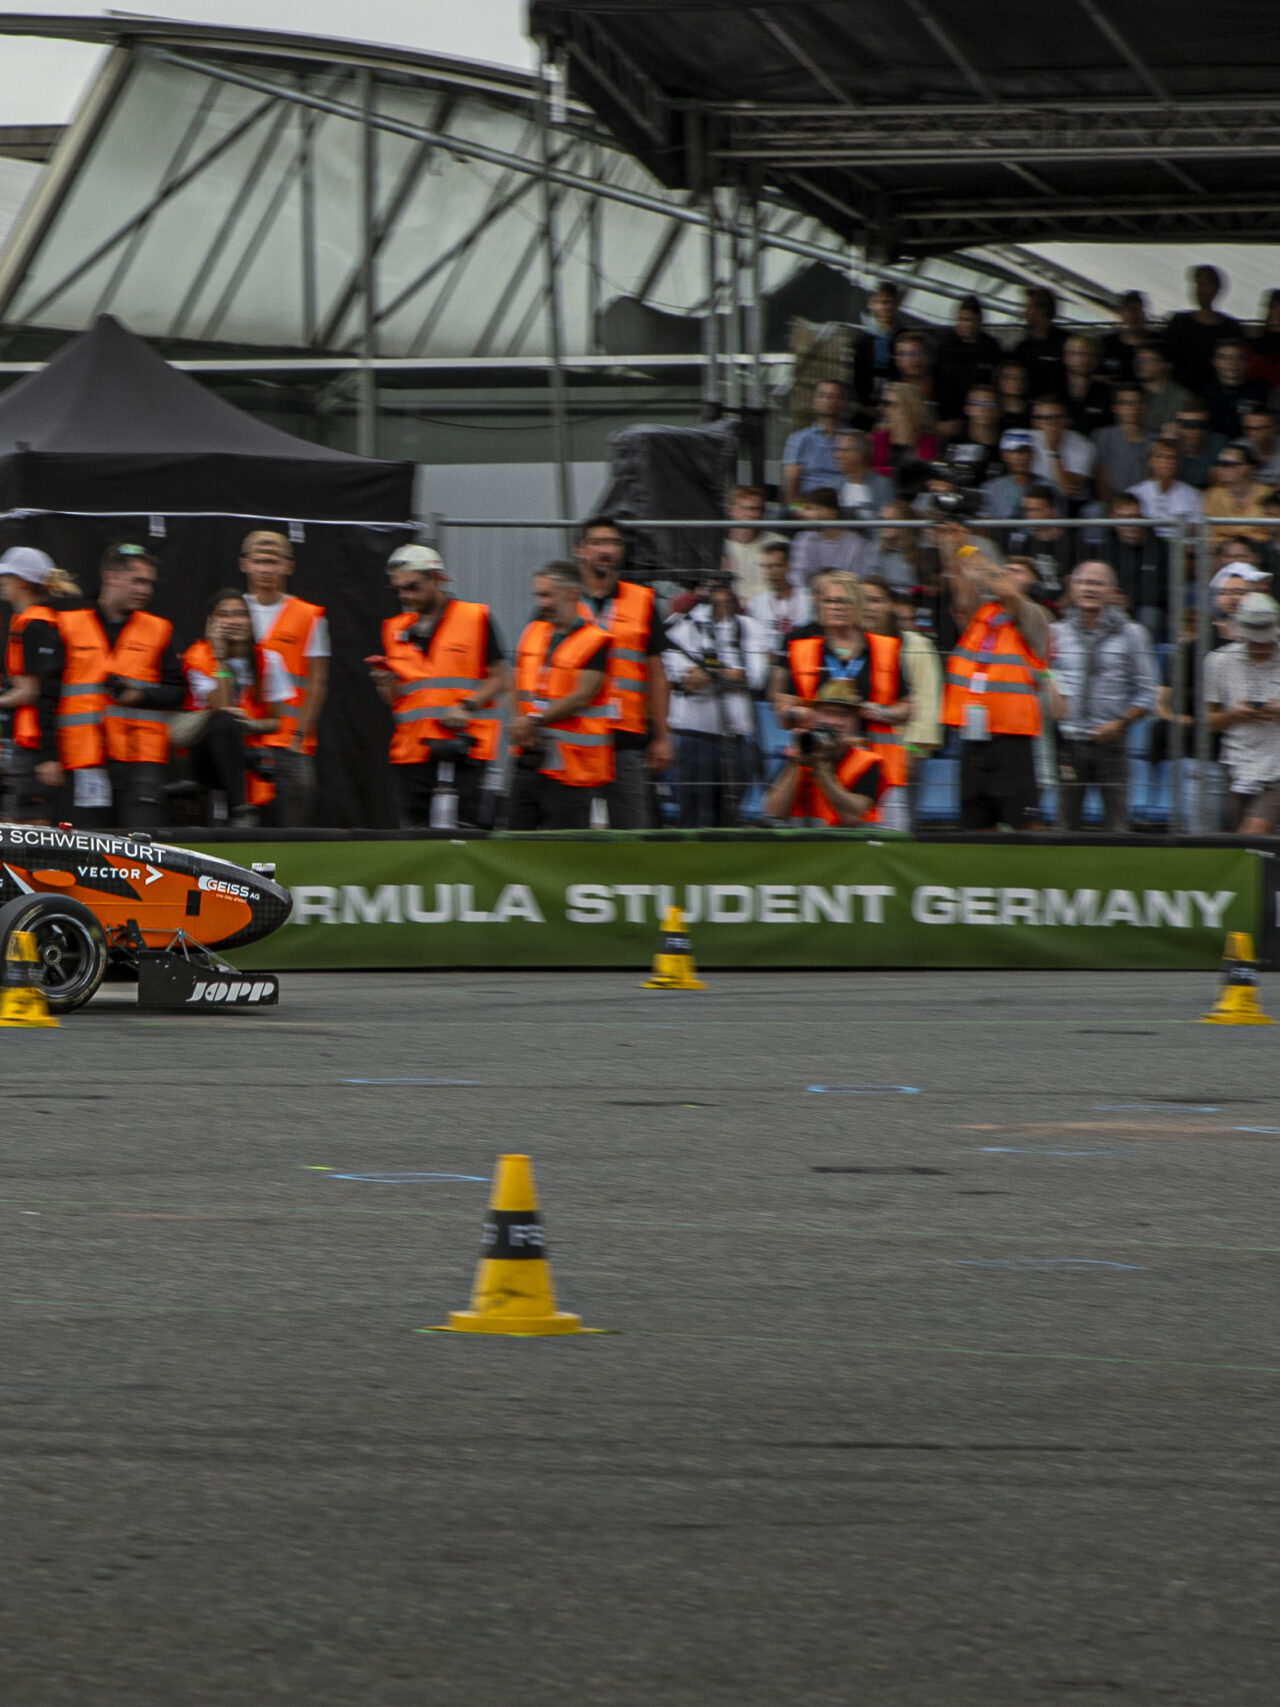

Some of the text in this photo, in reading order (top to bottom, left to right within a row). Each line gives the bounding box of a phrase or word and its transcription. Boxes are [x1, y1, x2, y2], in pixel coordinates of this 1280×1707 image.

[10, 831, 166, 863] SCHWEINFURT
[77, 866, 141, 880] VECTOR
[207, 878, 250, 898] GEISS
[249, 892, 260, 901] AG
[565, 884, 896, 925] STUDENT
[911, 886, 1238, 929] GERMANY
[185, 982, 275, 1002] JOPP
